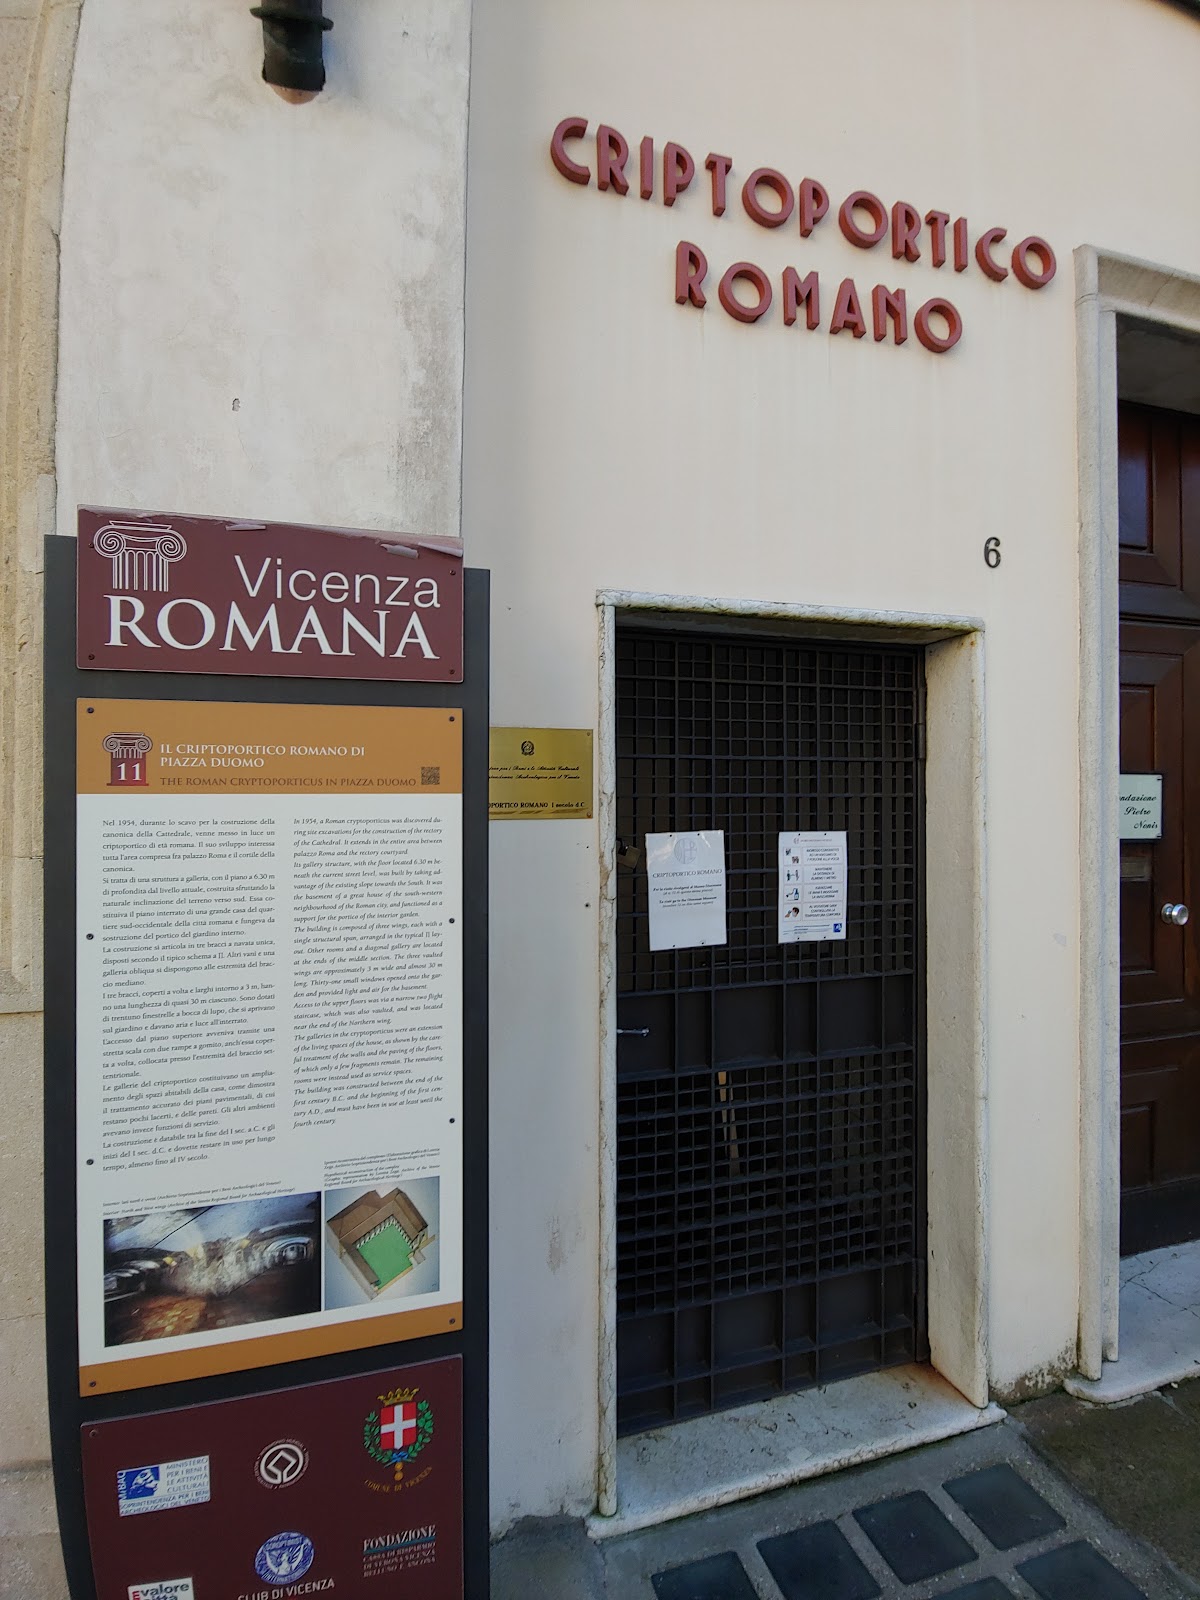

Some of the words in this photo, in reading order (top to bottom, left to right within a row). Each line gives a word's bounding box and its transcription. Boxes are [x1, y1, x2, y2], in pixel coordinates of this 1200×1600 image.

[551, 117, 1057, 290] CRIPTOPORTICO
[675, 241, 963, 353] ROMANO
[984, 536, 1001, 568] 6
[235, 555, 440, 608] Vicenza
[104, 595, 440, 660] ROMANA
[160, 744, 173, 755] IL
[176, 744, 286, 756] CRIPTOPORTICO
[289, 746, 348, 756] ROMANO
[351, 746, 365, 756] DI
[118, 762, 142, 781] 11
[160, 757, 206, 768] PIAZZA
[211, 757, 265, 768] DUOMO
[160, 777, 183, 786] THE
[186, 777, 227, 786] ROMAN
[230, 777, 323, 787] CRYPTOPORTICUS
[326, 778, 337, 786] IN
[340, 777, 374, 787] PIAZZA
[376, 777, 416, 787] DUOMO
[1124, 806, 1151, 815] Pietro
[166, 1458, 208, 1469] MINISTERO
[167, 1481, 209, 1493] CULTURALI
[363, 1524, 436, 1551] FONDAZIONE
[272, 1586, 283, 1599] DI
[286, 1578, 335, 1596] VICENZA
